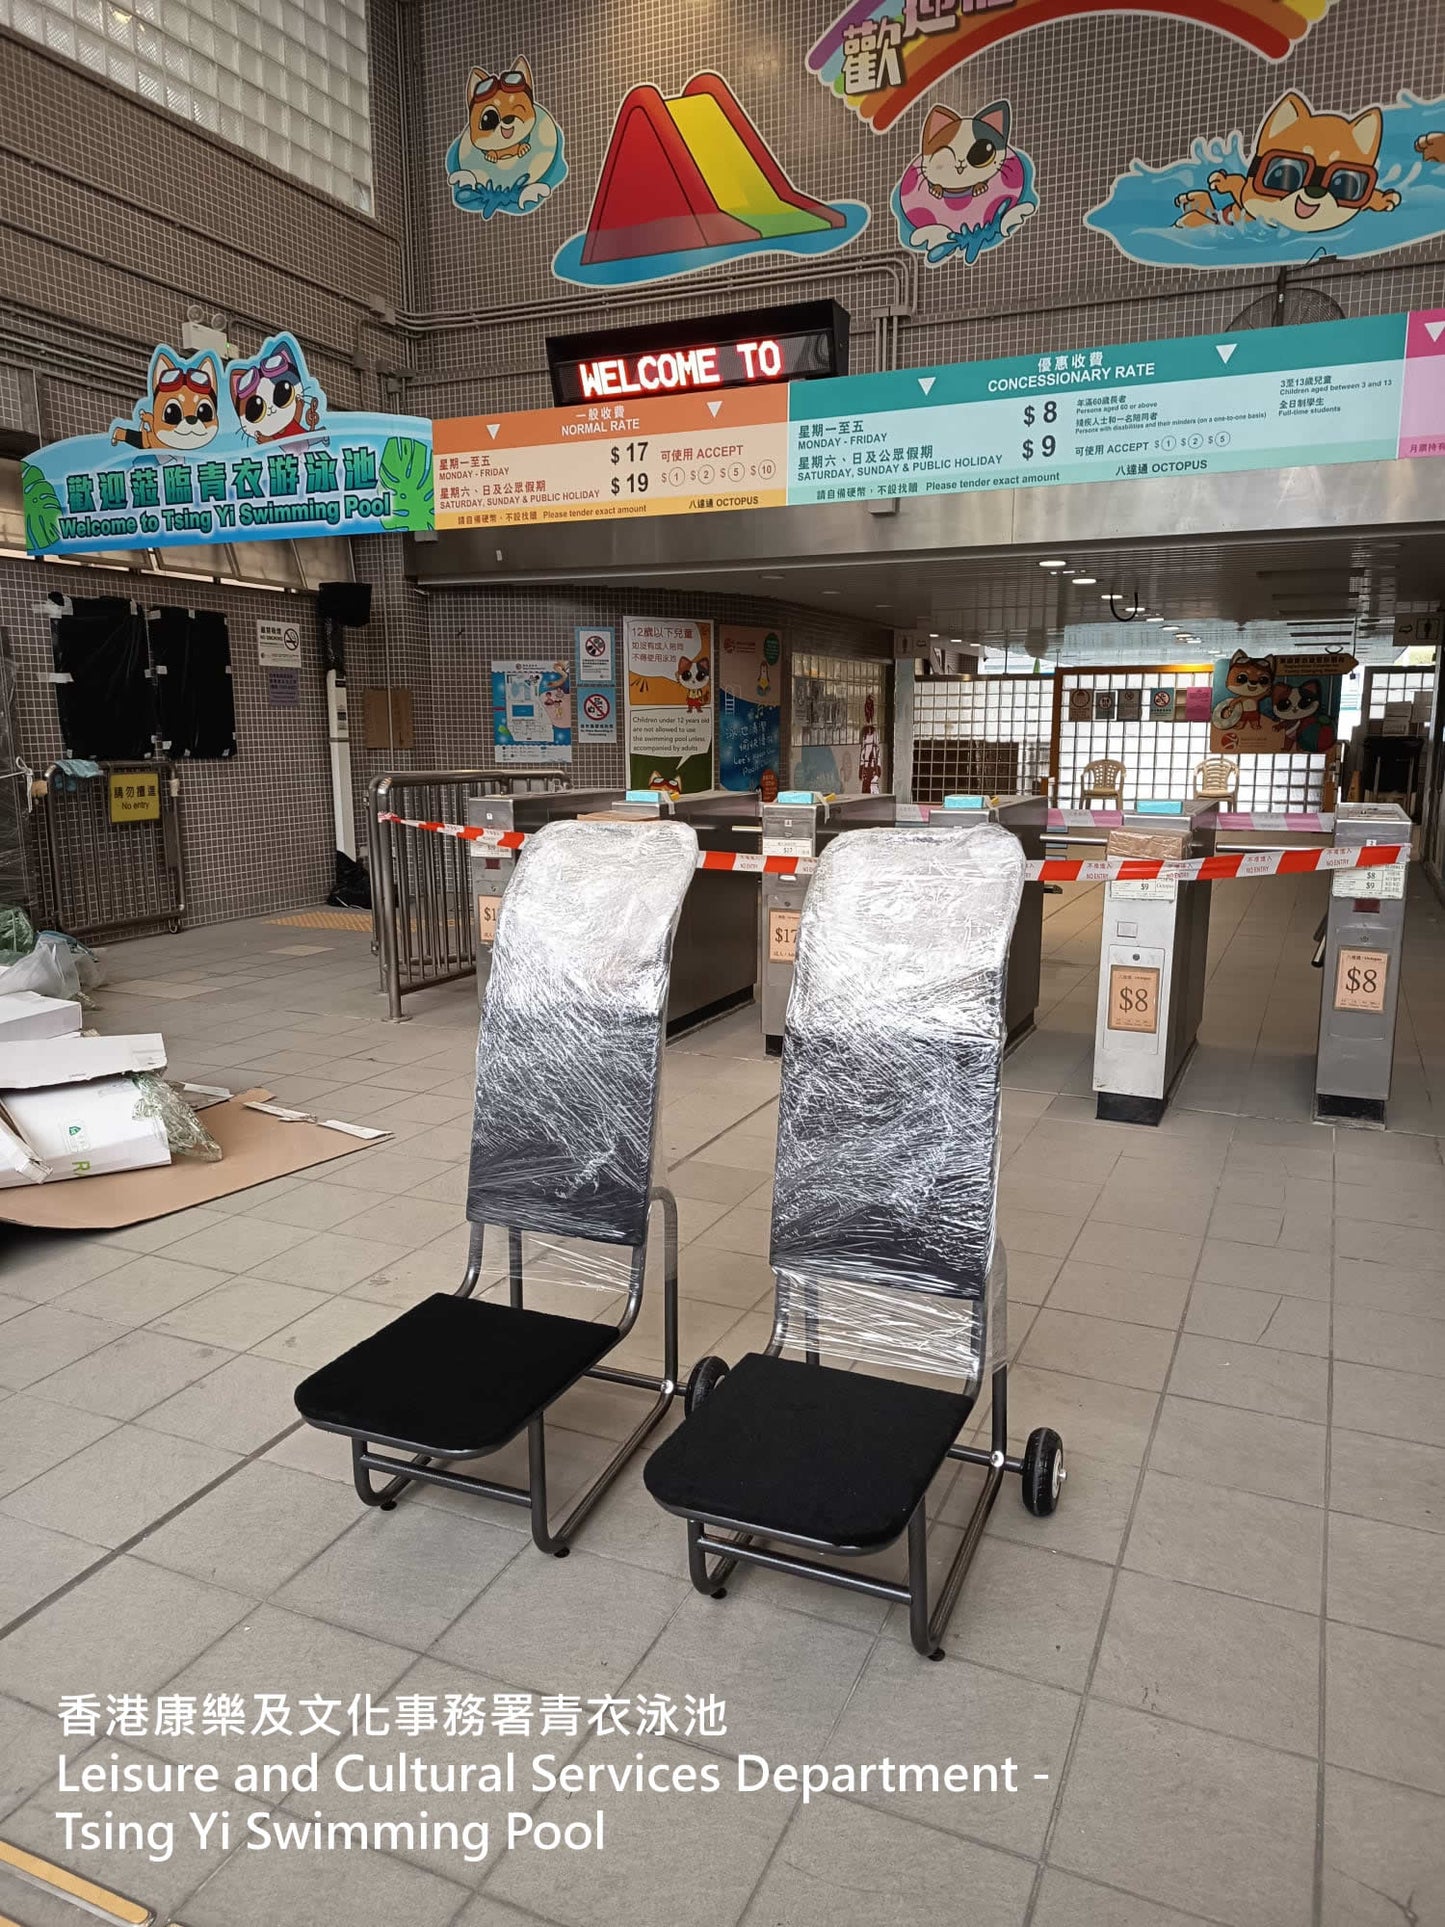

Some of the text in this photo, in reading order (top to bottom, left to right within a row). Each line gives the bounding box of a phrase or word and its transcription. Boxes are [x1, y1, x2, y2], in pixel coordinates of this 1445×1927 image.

[578, 340, 782, 398] WELCOME TO
[1038, 351, 1104, 373] 優惠收費
[988, 363, 1156, 392] CONCESSIONARY RATE
[1280, 387, 1310, 395] Children
[1311, 385, 1328, 394] aged
[1330, 383, 1360, 391] between
[576, 405, 625, 421] 一般收費
[1023, 400, 1058, 427] $ 8
[1103, 405, 1119, 413] aged
[1137, 401, 1158, 409] above
[1278, 406, 1341, 417] Full-time students
[561, 418, 640, 437] NORMAL RATE
[798, 420, 864, 439] 星期一至五
[798, 432, 888, 450] MONDAY FRIDAY
[1022, 435, 1056, 461] $ 9
[1075, 441, 1150, 457] 可使用 ACCEPT
[439, 455, 491, 471] 星期一至五
[610, 441, 649, 466] $ 17
[660, 444, 744, 463] 可使用 ACCEPT
[798, 444, 933, 470] 星期六、日及公眾假期
[439, 466, 510, 481] MONDAY FRIDAY
[798, 454, 1003, 482] SATURDAY, SUNDAY & PUBLIC HOLIDAY
[1115, 459, 1208, 477] 八達通 OCTOPUS
[66, 447, 378, 514] 歡迎蒞臨青衣游泳池
[440, 480, 546, 500] 星期六、日及公眾假期
[611, 472, 649, 496] $ 19
[926, 481, 958, 492] Please
[959, 477, 991, 489] tender
[992, 474, 1020, 485] exact
[1022, 471, 1060, 484] amount
[440, 489, 600, 510] SATURDAY, SUNDAY & PUBLIC HOLIDAY
[688, 495, 759, 510] 八達通 OCTOPUS
[59, 492, 392, 539] Welcome to Tsing Yi Swimming Pool
[543, 508, 568, 519] Please
[569, 507, 594, 518] tender
[595, 504, 616, 516] exact
[617, 504, 647, 515] amount
[632, 627, 693, 639] 12歲以下兒童
[632, 716, 658, 724] Children
[685, 718, 700, 726] years
[673, 744, 680, 752] by
[674, 735, 687, 743] pool
[121, 802, 132, 810] No
[1345, 965, 1377, 994] $8
[1119, 985, 1148, 1014] $8
